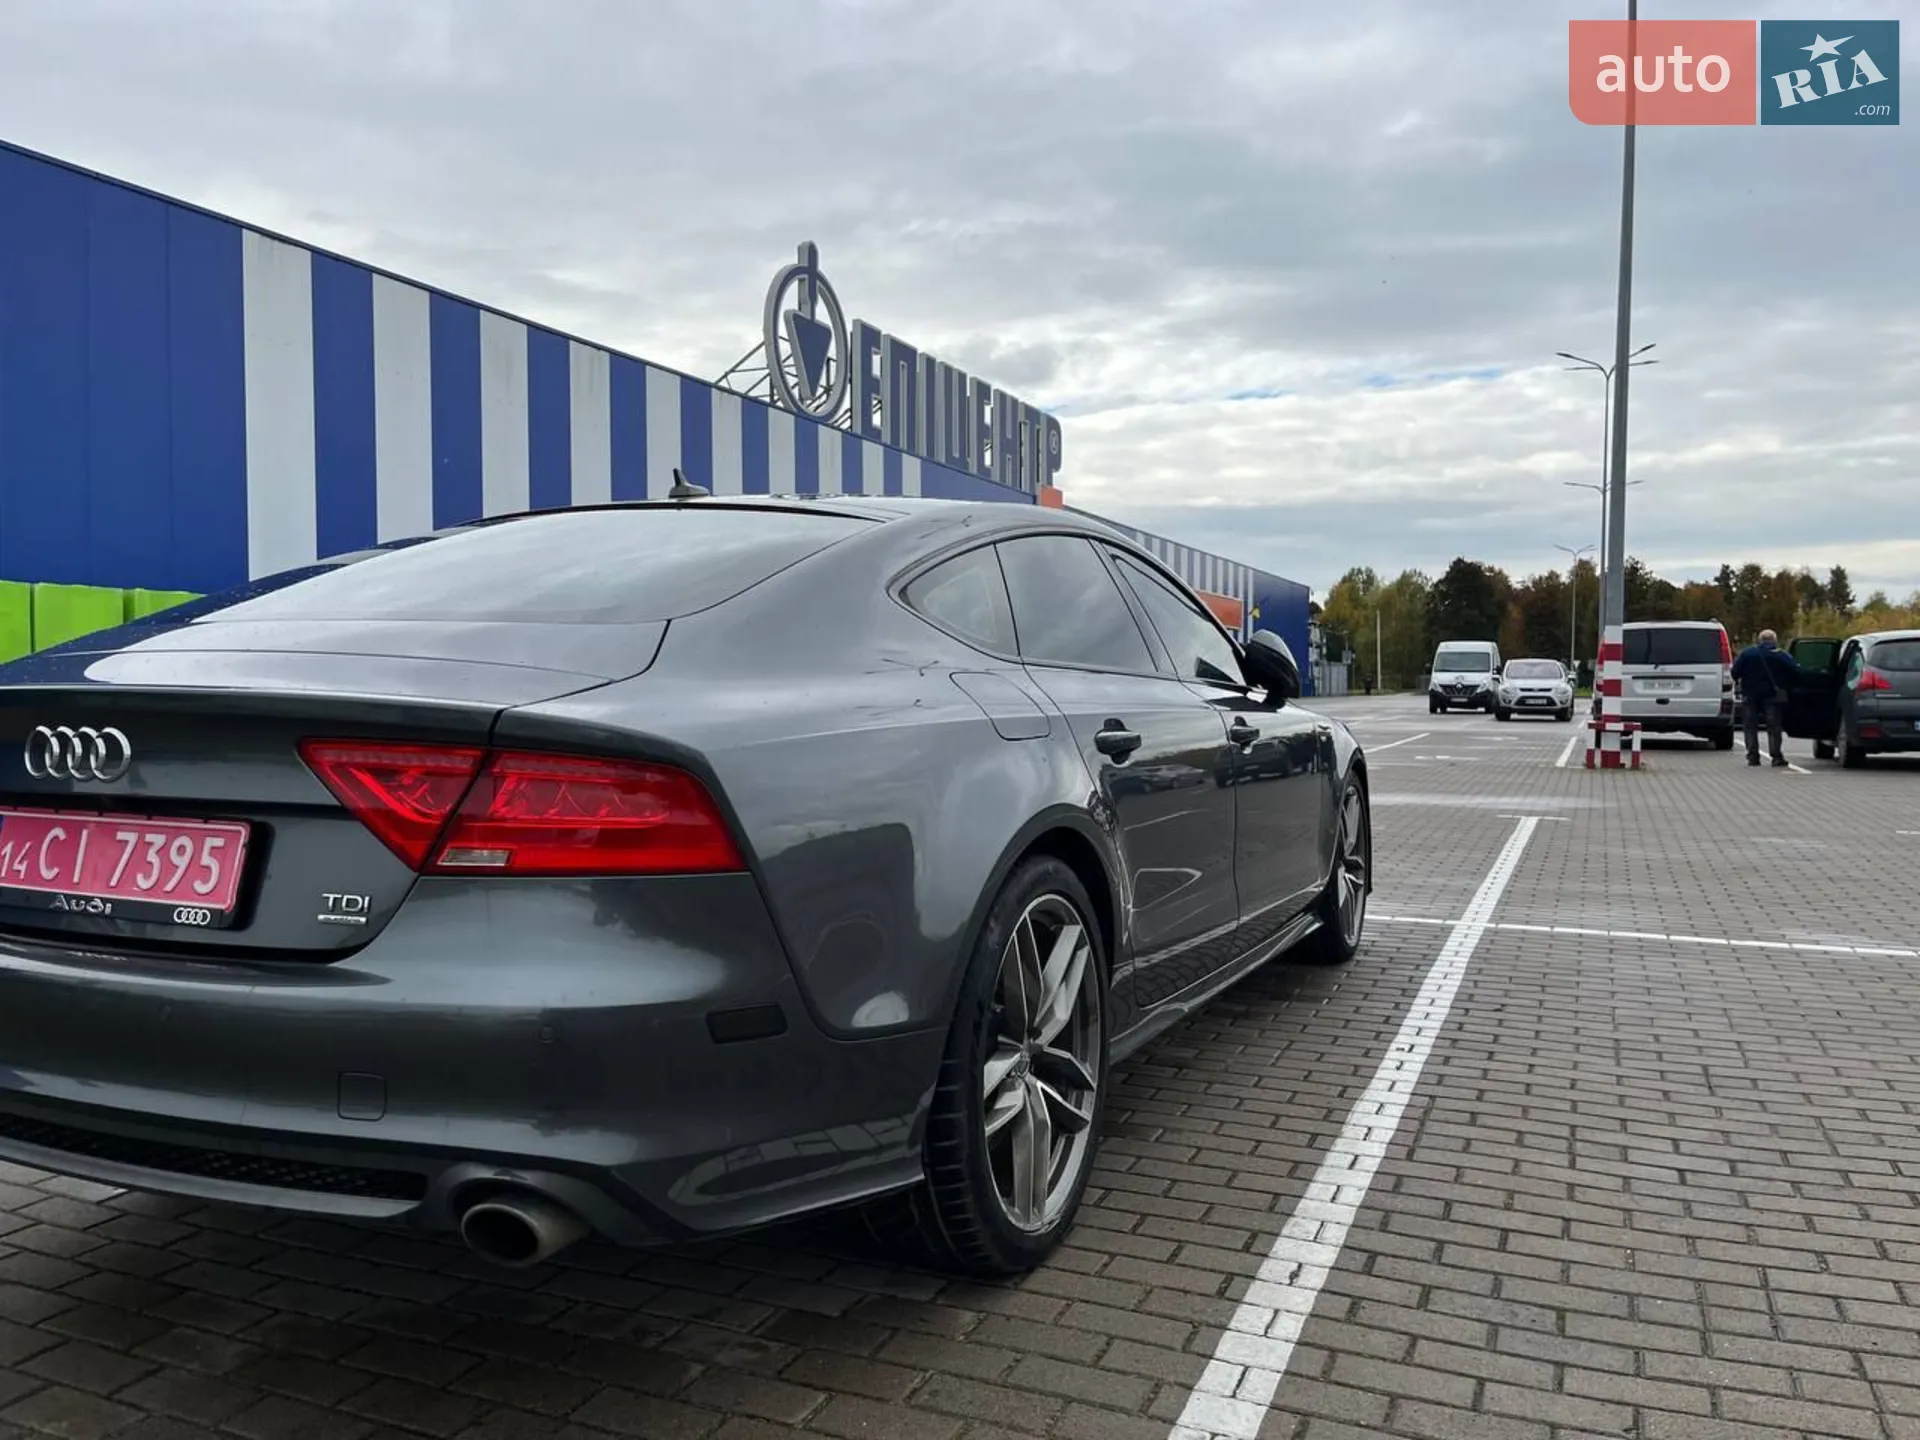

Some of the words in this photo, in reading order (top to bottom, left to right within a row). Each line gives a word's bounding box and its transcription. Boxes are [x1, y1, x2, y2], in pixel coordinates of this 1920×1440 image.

[0, 840, 32, 880] 14
[109, 831, 226, 895] 7395
[49, 894, 112, 915] Audi
[322, 893, 370, 913] TDI
